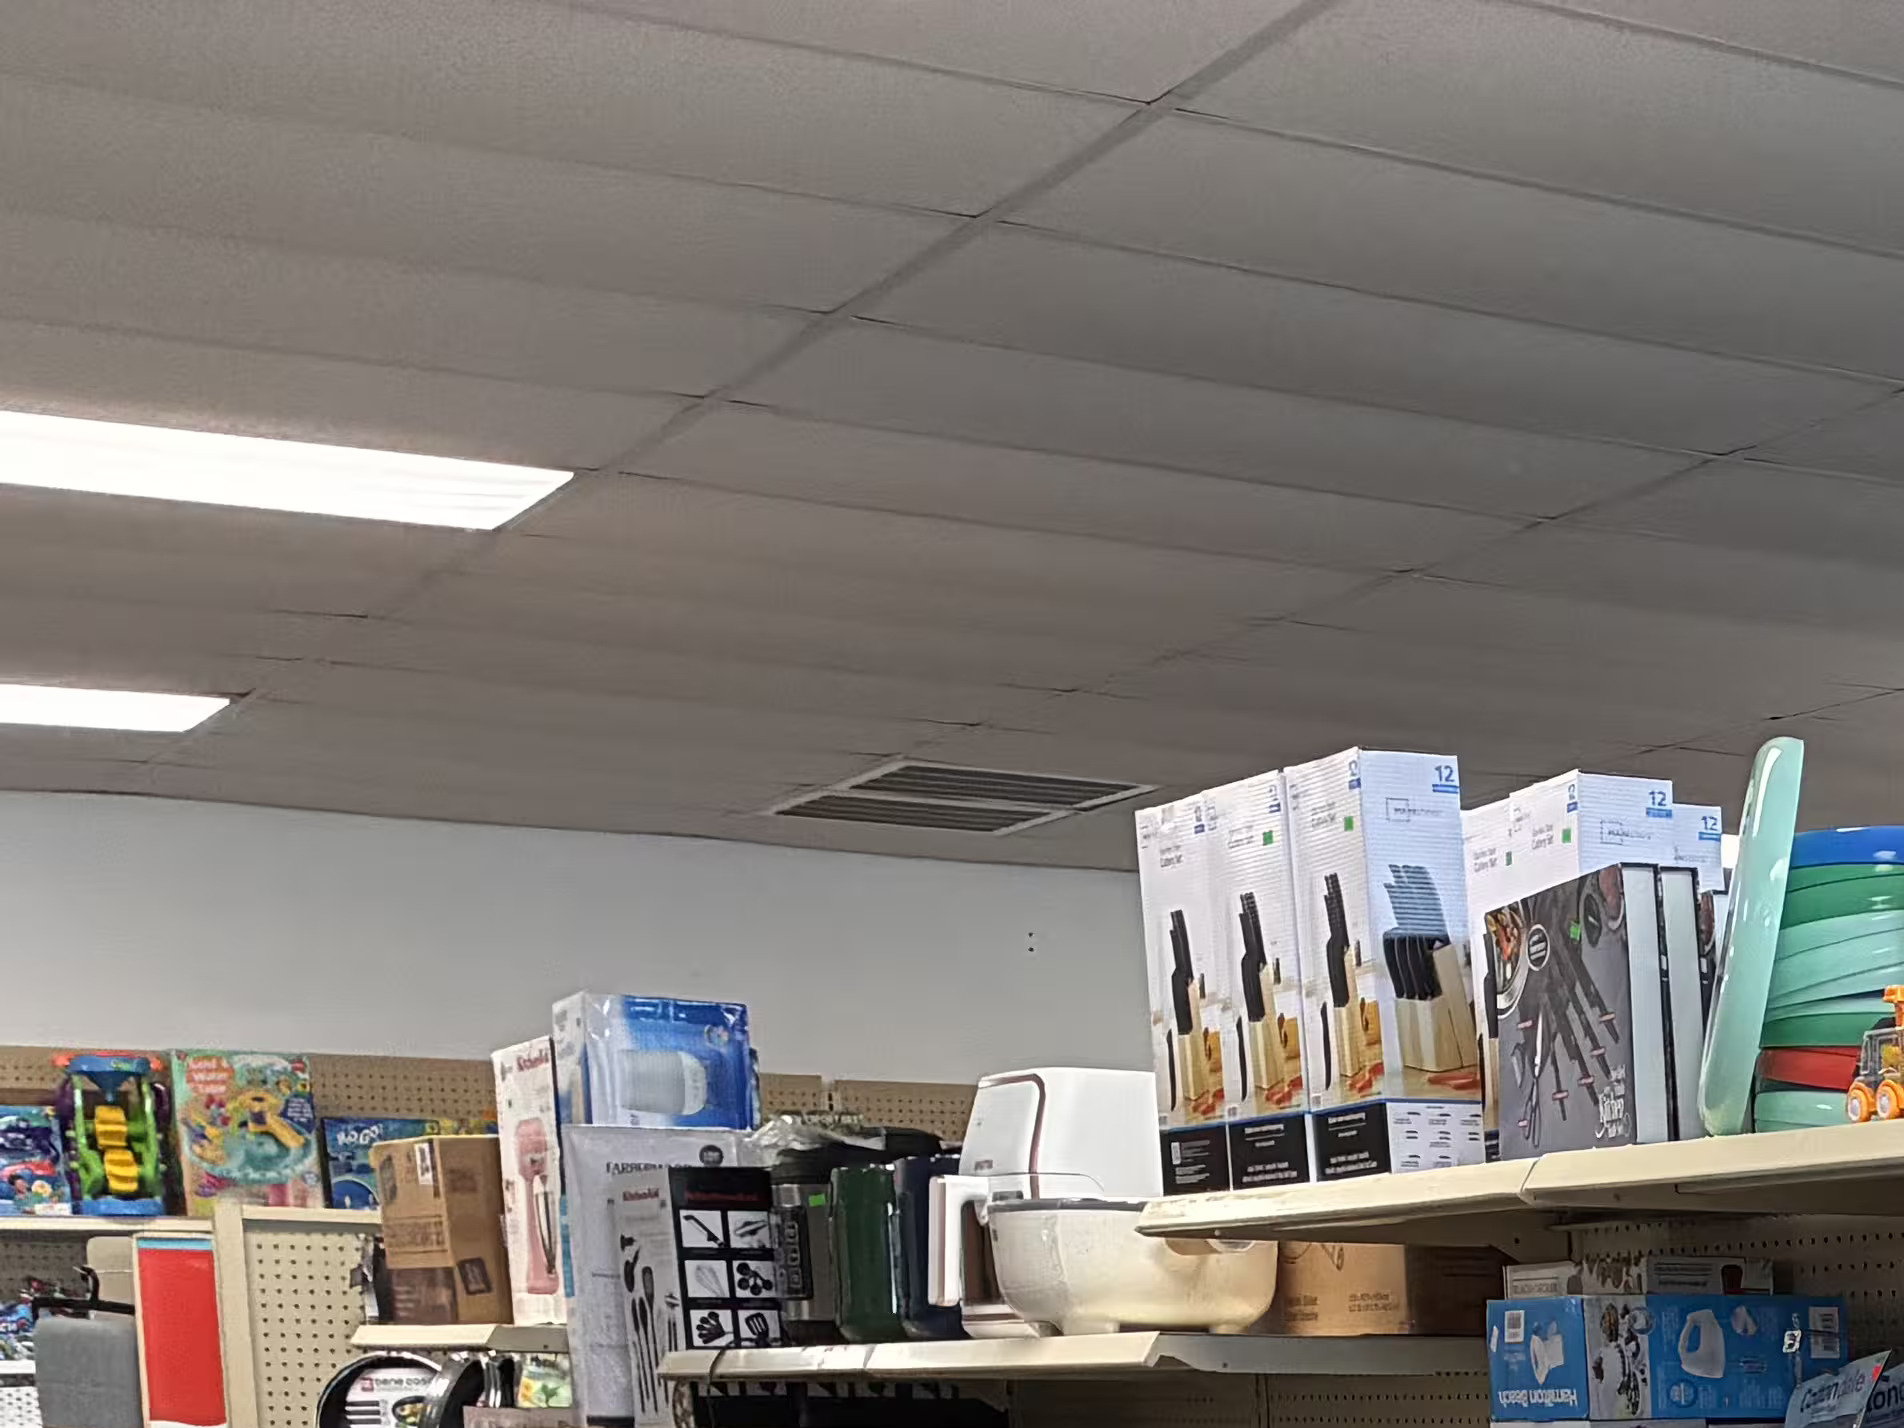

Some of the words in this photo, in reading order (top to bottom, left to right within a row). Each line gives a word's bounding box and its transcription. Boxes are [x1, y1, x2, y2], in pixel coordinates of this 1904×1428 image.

[1435, 765, 1454, 782] 12
[1649, 791, 1666, 806] 12
[1700, 816, 1718, 831] 12
